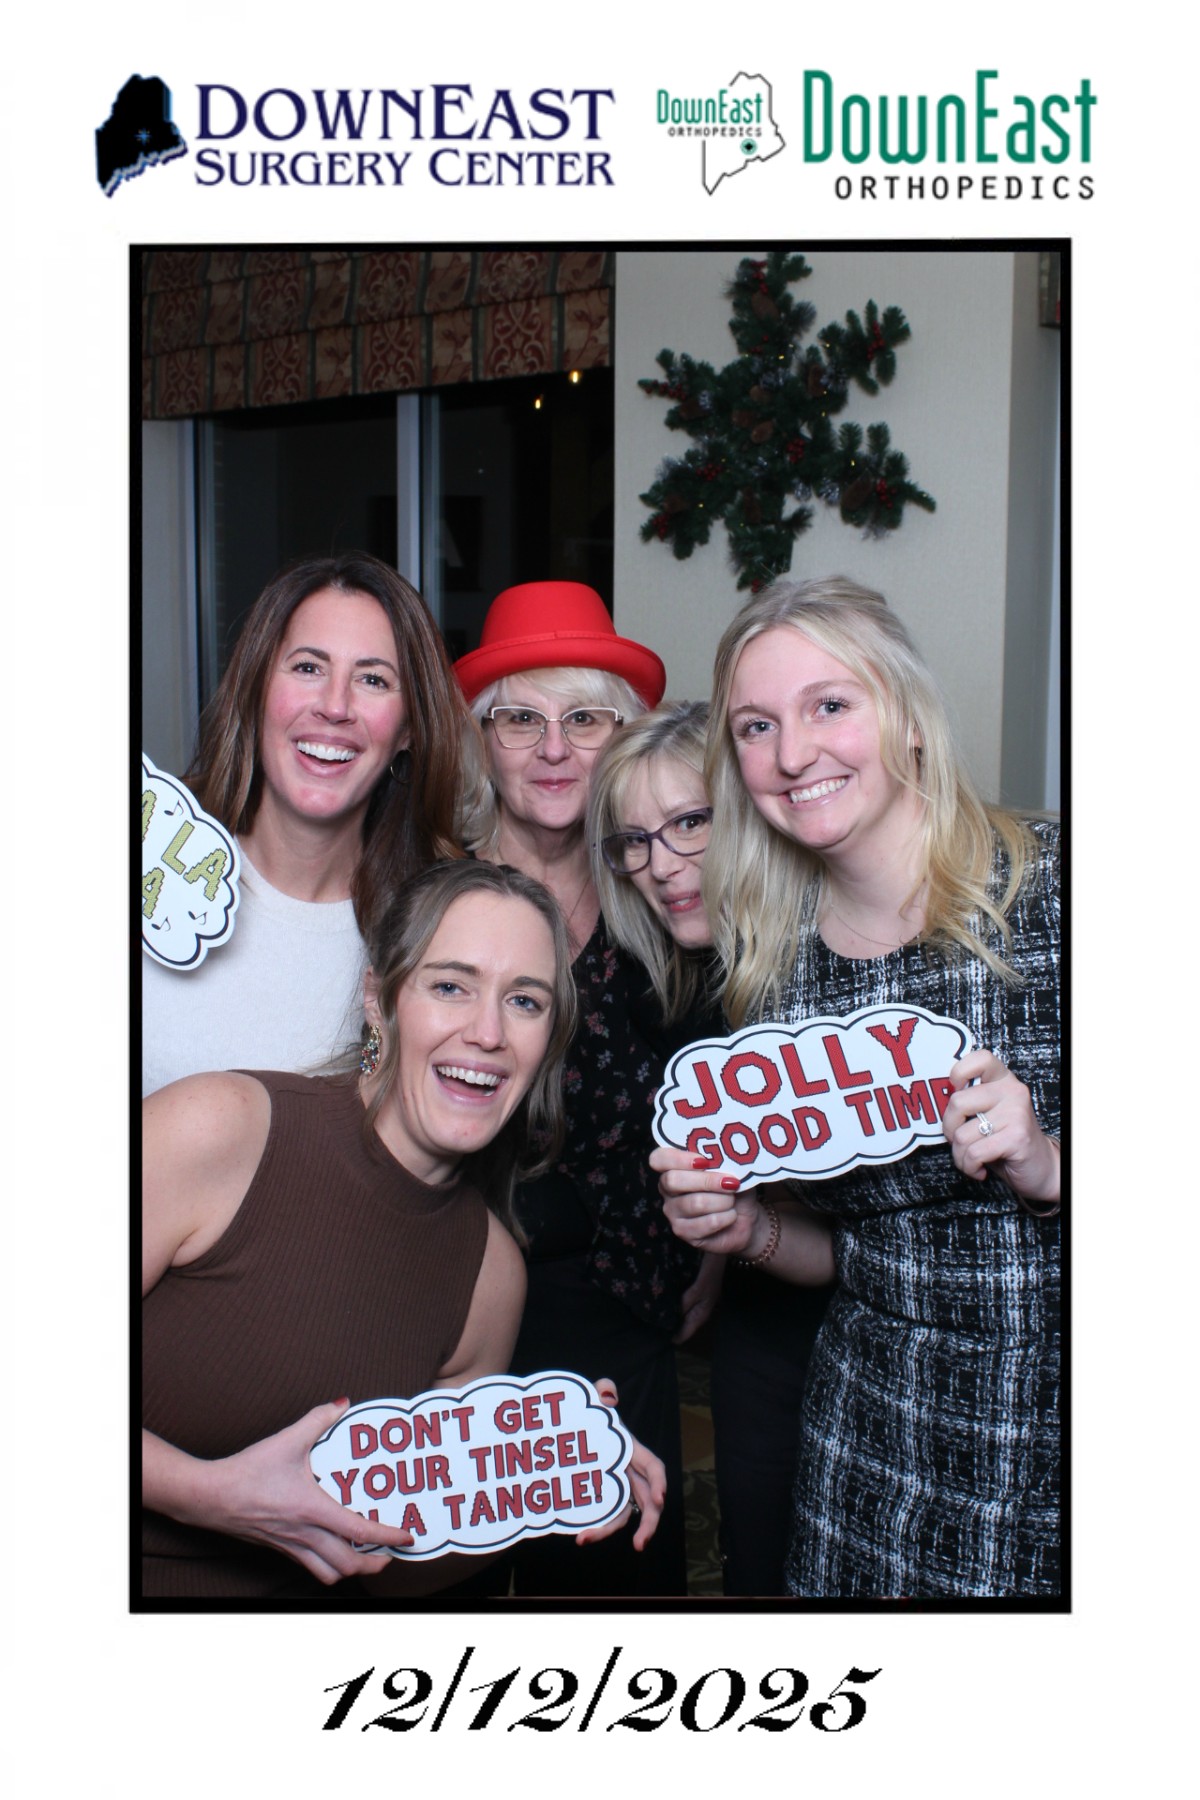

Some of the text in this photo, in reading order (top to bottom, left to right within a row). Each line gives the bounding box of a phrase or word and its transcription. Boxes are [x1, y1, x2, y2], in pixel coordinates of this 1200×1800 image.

[161, 820, 227, 902] LA
[673, 1017, 919, 1119] JOLLY
[686, 1106, 832, 1169] GOOD
[350, 1391, 565, 1460] DON'T GET
[331, 1430, 598, 1506] YOUR TINSEL
[401, 1502, 427, 1537] A
[443, 1469, 603, 1530] TANGLE!
